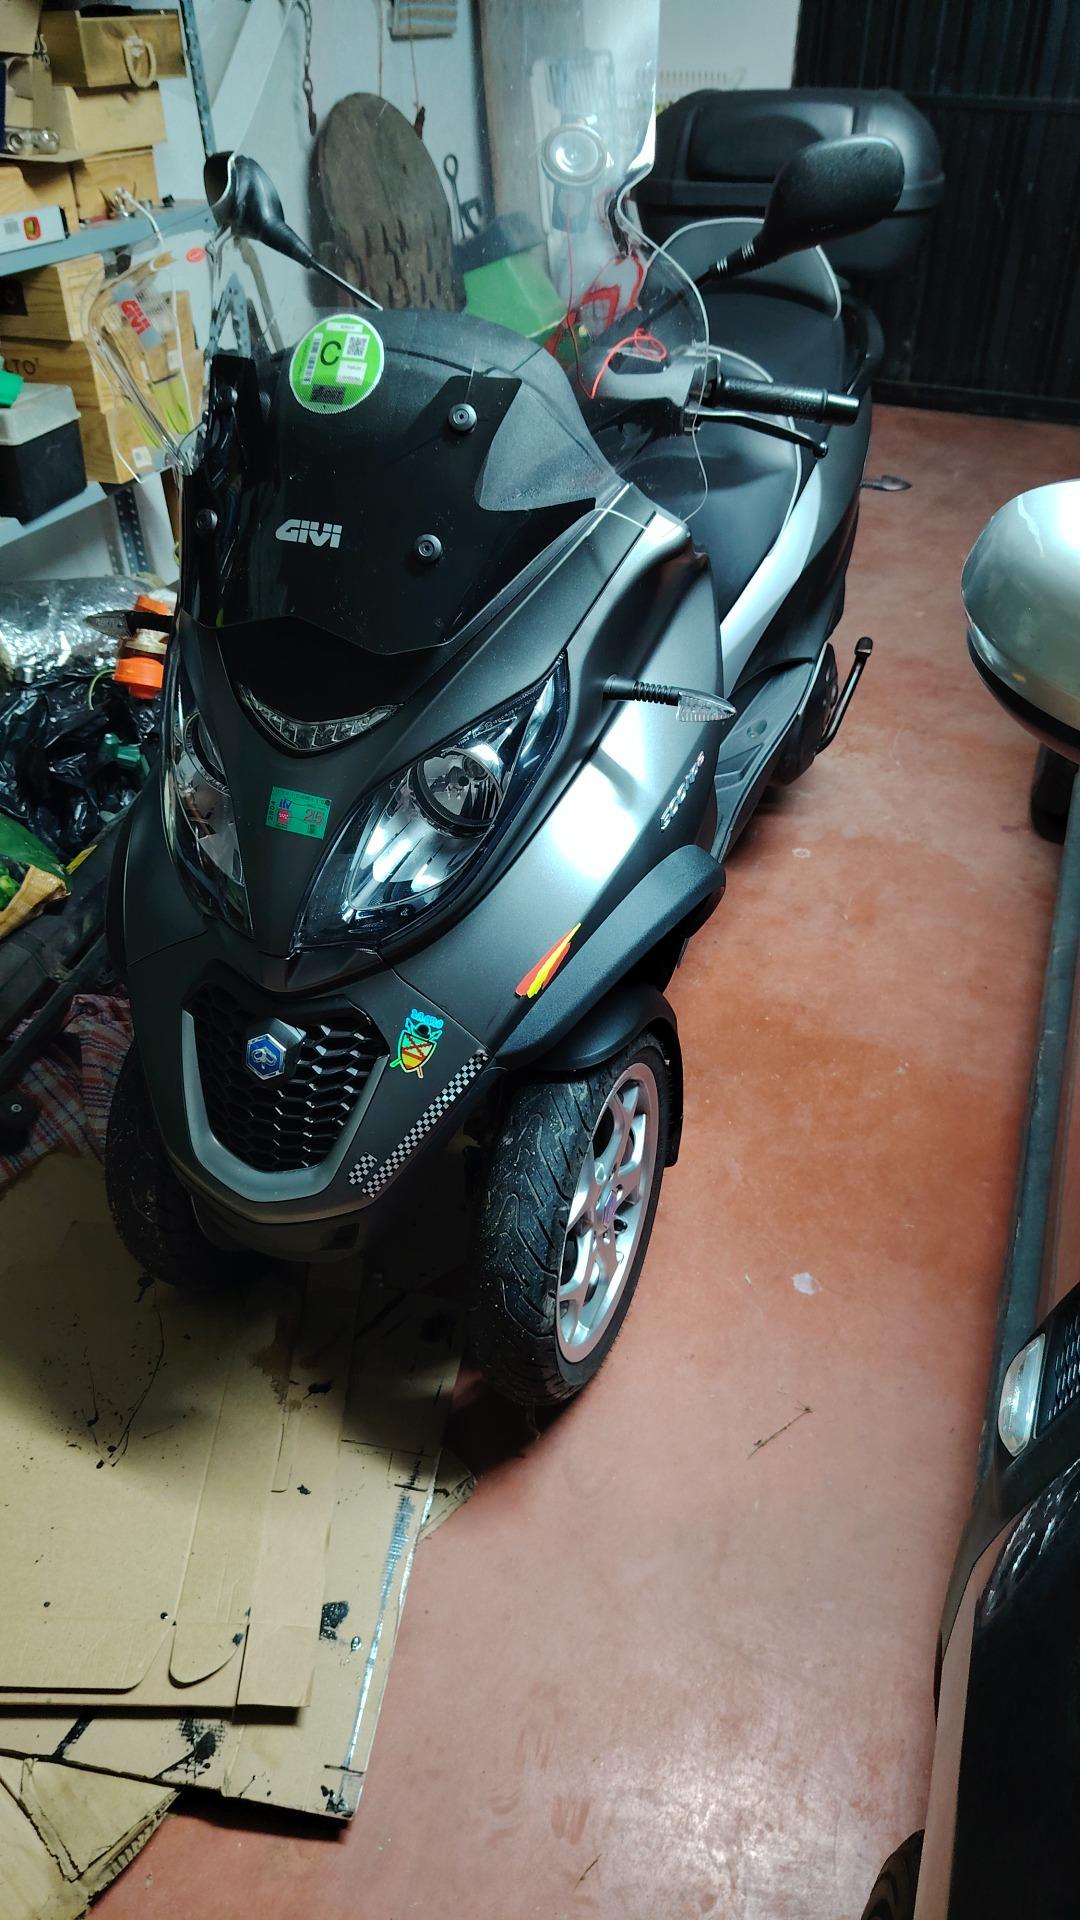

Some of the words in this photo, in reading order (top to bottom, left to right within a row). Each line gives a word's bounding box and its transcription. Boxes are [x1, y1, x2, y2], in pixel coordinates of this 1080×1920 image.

[320, 341, 342, 366] C
[275, 518, 342, 548] GIVI
[304, 809, 322, 826] 25
